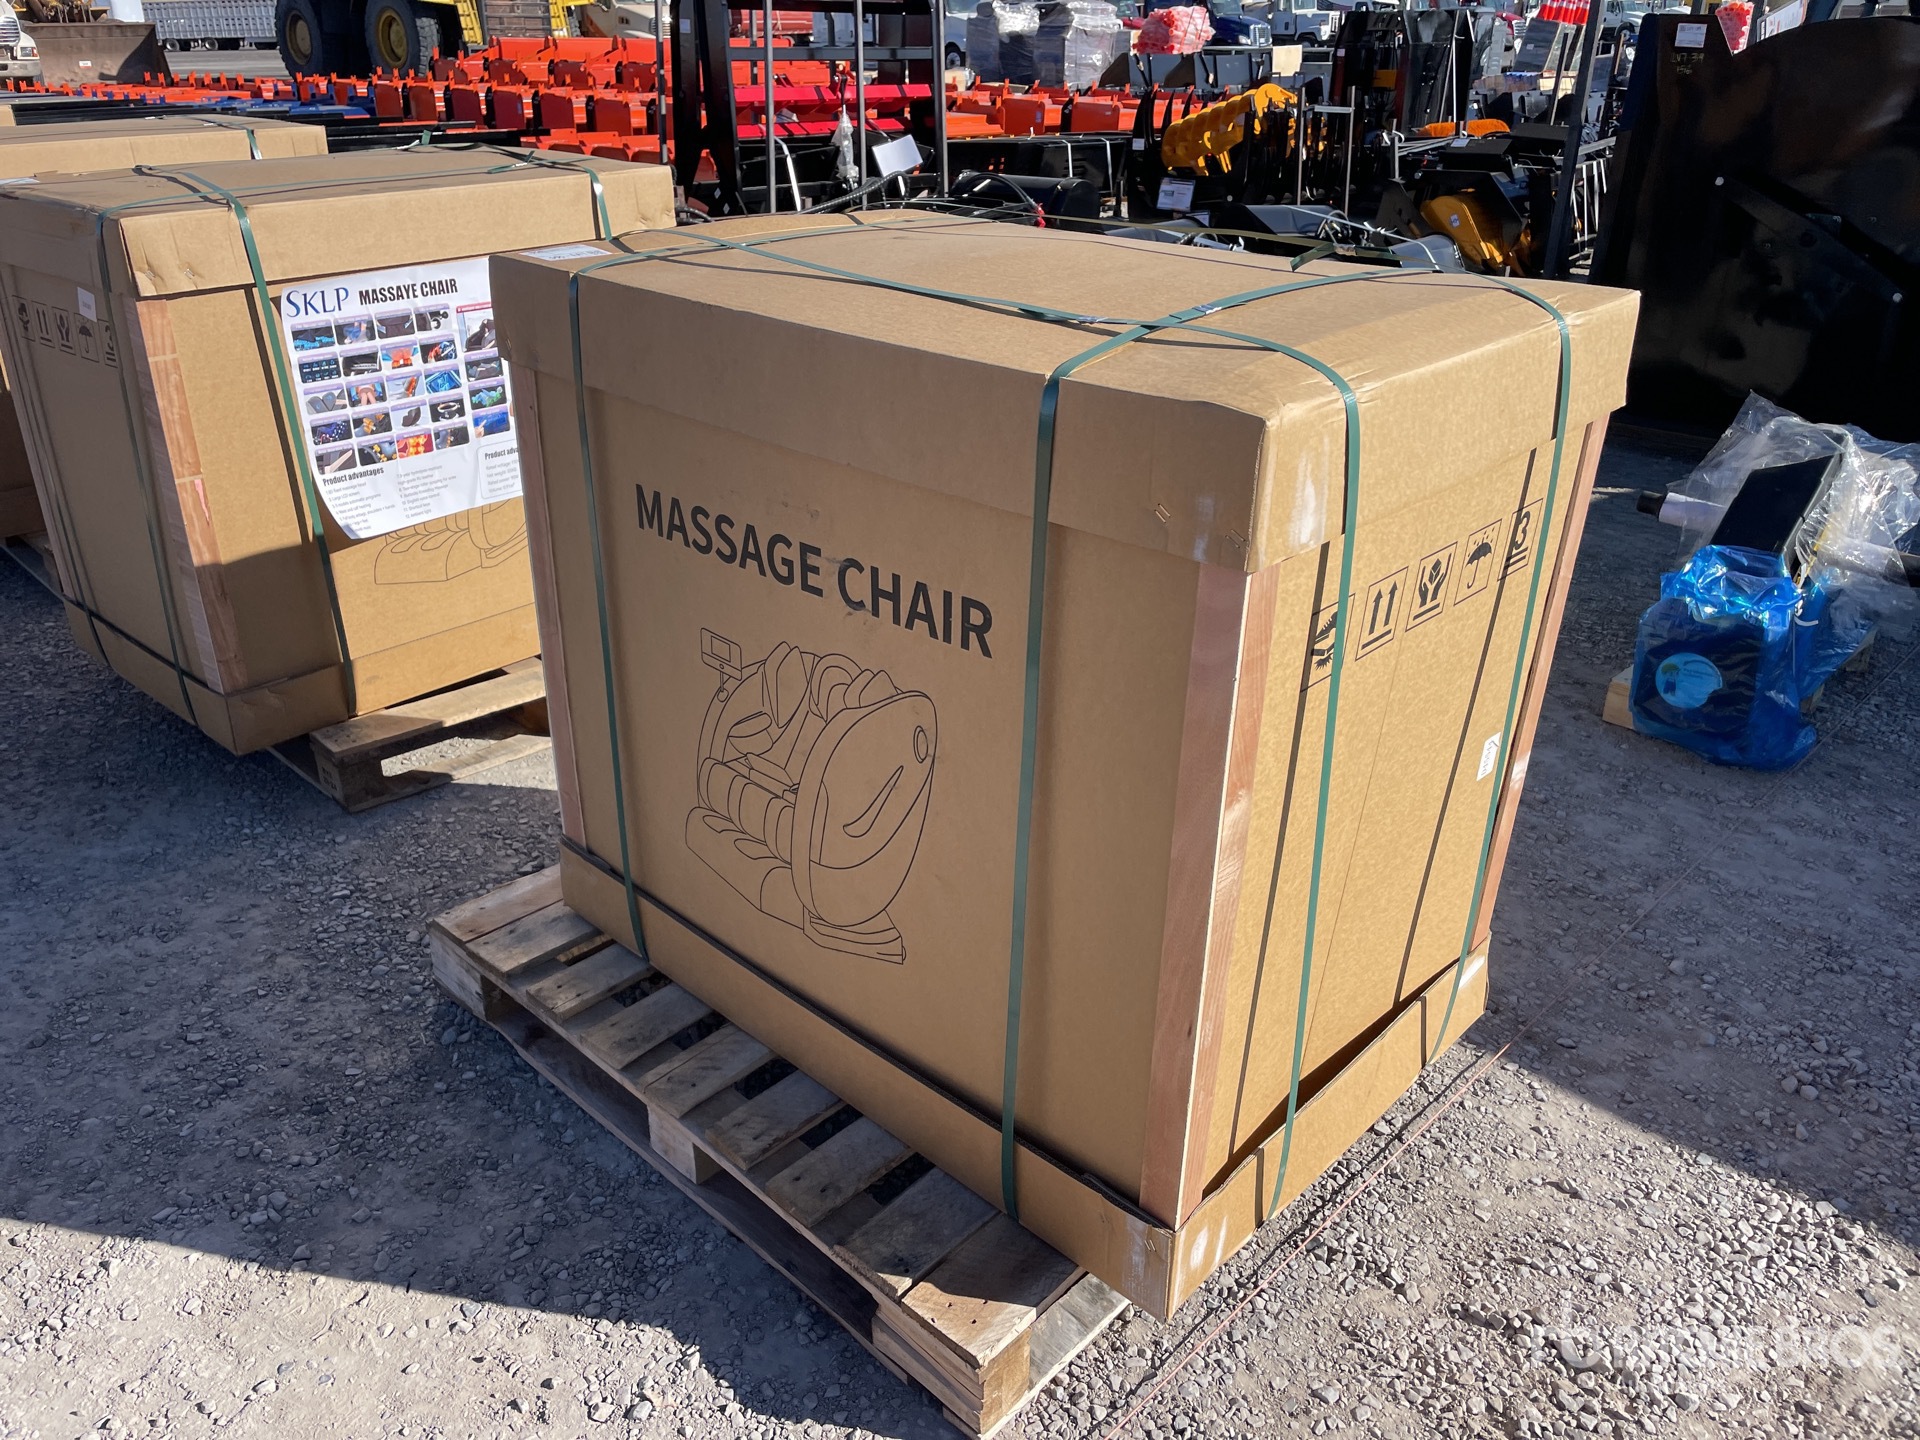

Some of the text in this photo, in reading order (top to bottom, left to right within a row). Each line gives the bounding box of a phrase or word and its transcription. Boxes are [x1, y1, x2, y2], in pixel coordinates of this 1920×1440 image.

[286, 287, 349, 318] SKLP
[358, 283, 419, 306] MASSAYE
[420, 278, 458, 297] CHAIR
[485, 449, 506, 460] Product
[322, 475, 347, 487] Product
[348, 467, 384, 481] advantages
[635, 483, 993, 659] MASSAGE CHAIR
